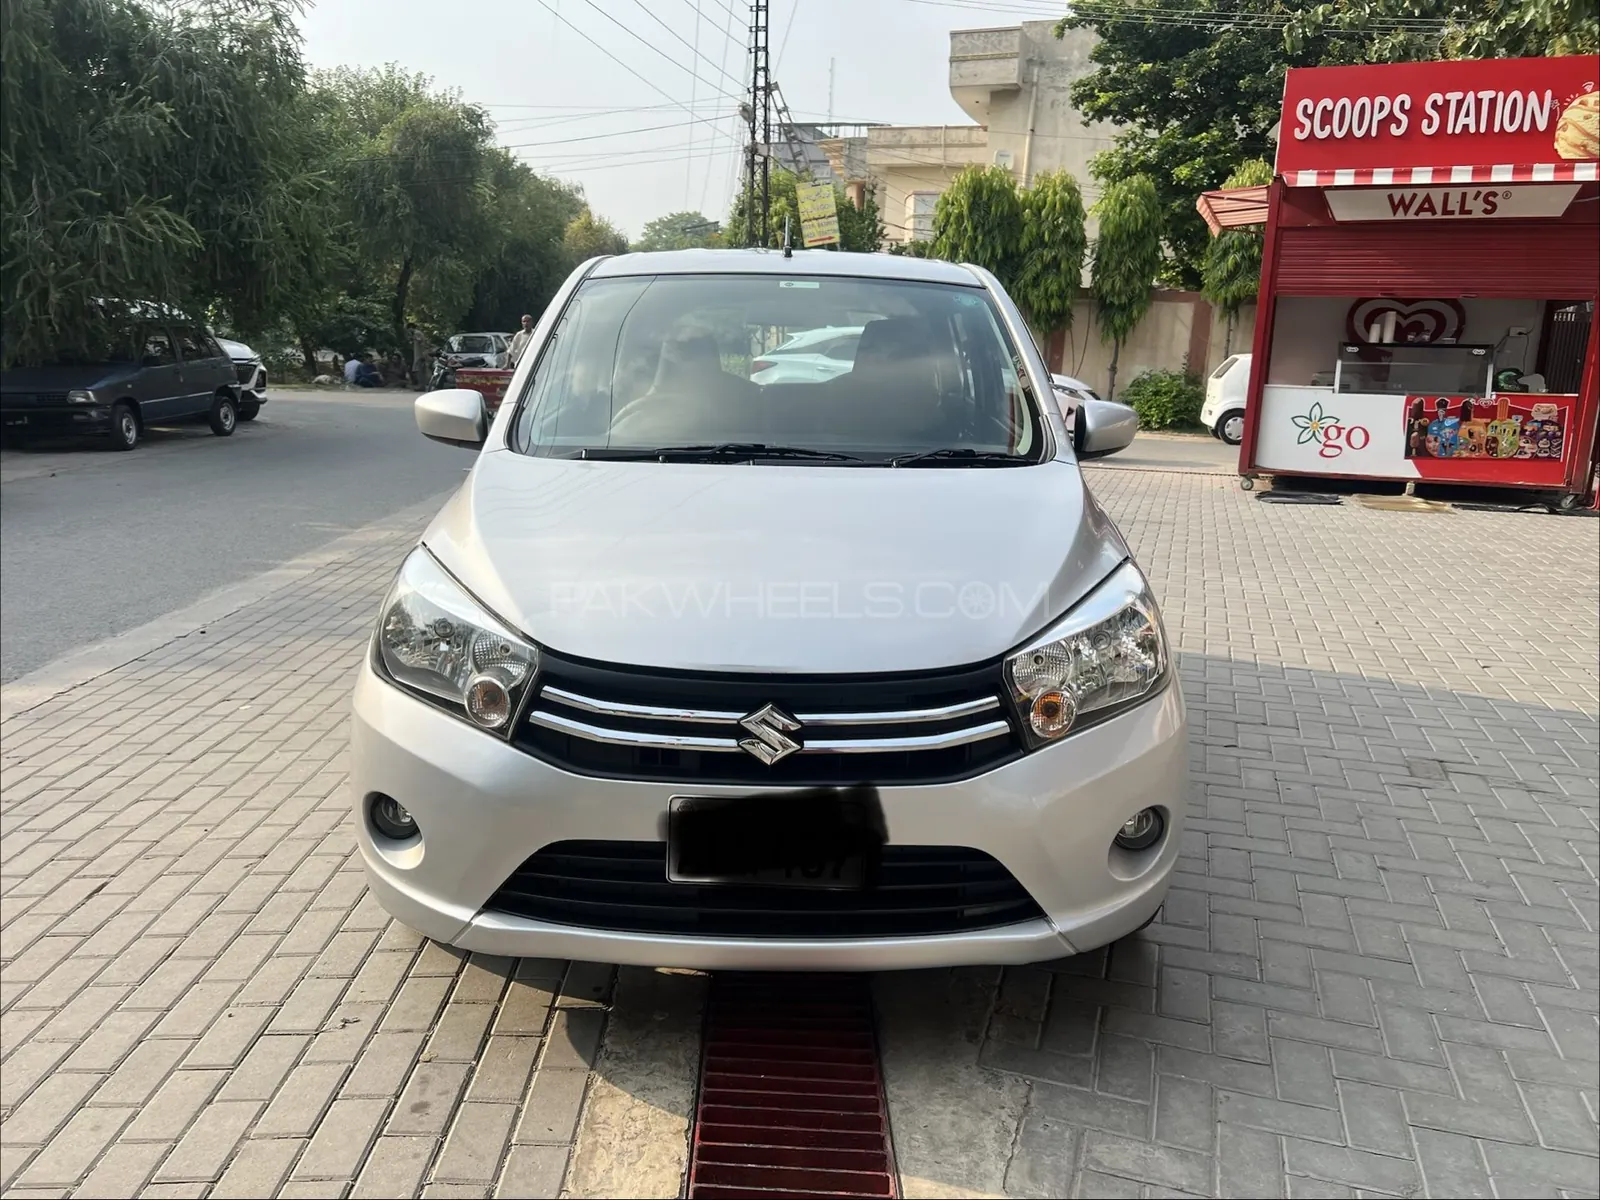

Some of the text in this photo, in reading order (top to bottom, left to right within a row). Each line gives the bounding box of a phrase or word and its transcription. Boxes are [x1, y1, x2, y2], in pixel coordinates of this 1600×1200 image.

[1294, 89, 1552, 140] SCOOPS STATION
[1319, 424, 1370, 458] go
